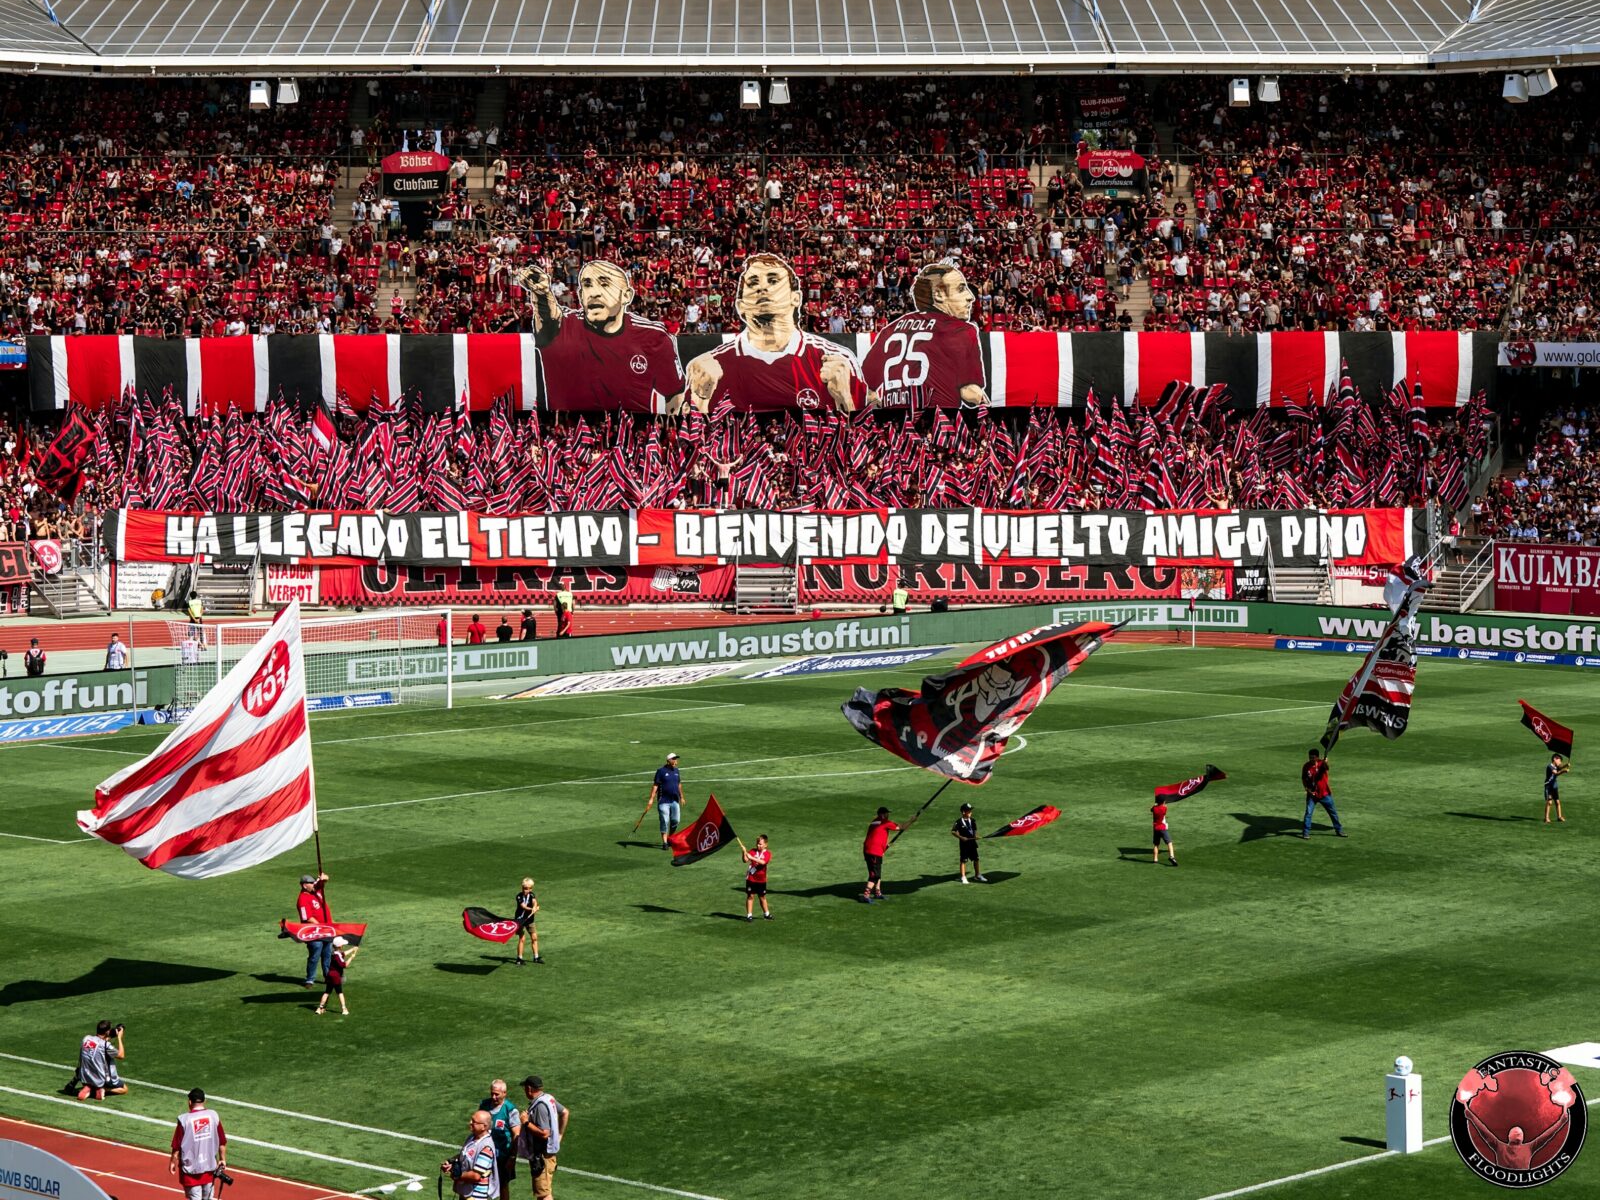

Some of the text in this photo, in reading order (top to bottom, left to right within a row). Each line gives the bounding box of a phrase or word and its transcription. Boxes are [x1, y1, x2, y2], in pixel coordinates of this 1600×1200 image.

[400, 155, 433, 168] Böhse
[393, 178, 440, 191] Clubfanz
[894, 319, 936, 332] PINOLA
[632, 361, 647, 370] FCN
[884, 332, 933, 390] 25
[166, 516, 220, 555] HA
[232, 513, 409, 557] LLEGADO
[420, 515, 469, 558] EL
[479, 515, 623, 557] TIEMPO
[675, 513, 908, 558] BIENVENIDO
[920, 513, 969, 555] DE
[982, 514, 1130, 558] VUELTO
[1142, 514, 1267, 559] AMIGO
[1281, 516, 1366, 558] PINO
[268, 563, 313, 579] STADION
[1245, 569, 1259, 578] YOU
[681, 579, 698, 588] 1994
[268, 584, 313, 602] VERBOT
[611, 617, 910, 666] www.baustoffuni
[24, 1174, 60, 1196] SOLAR
